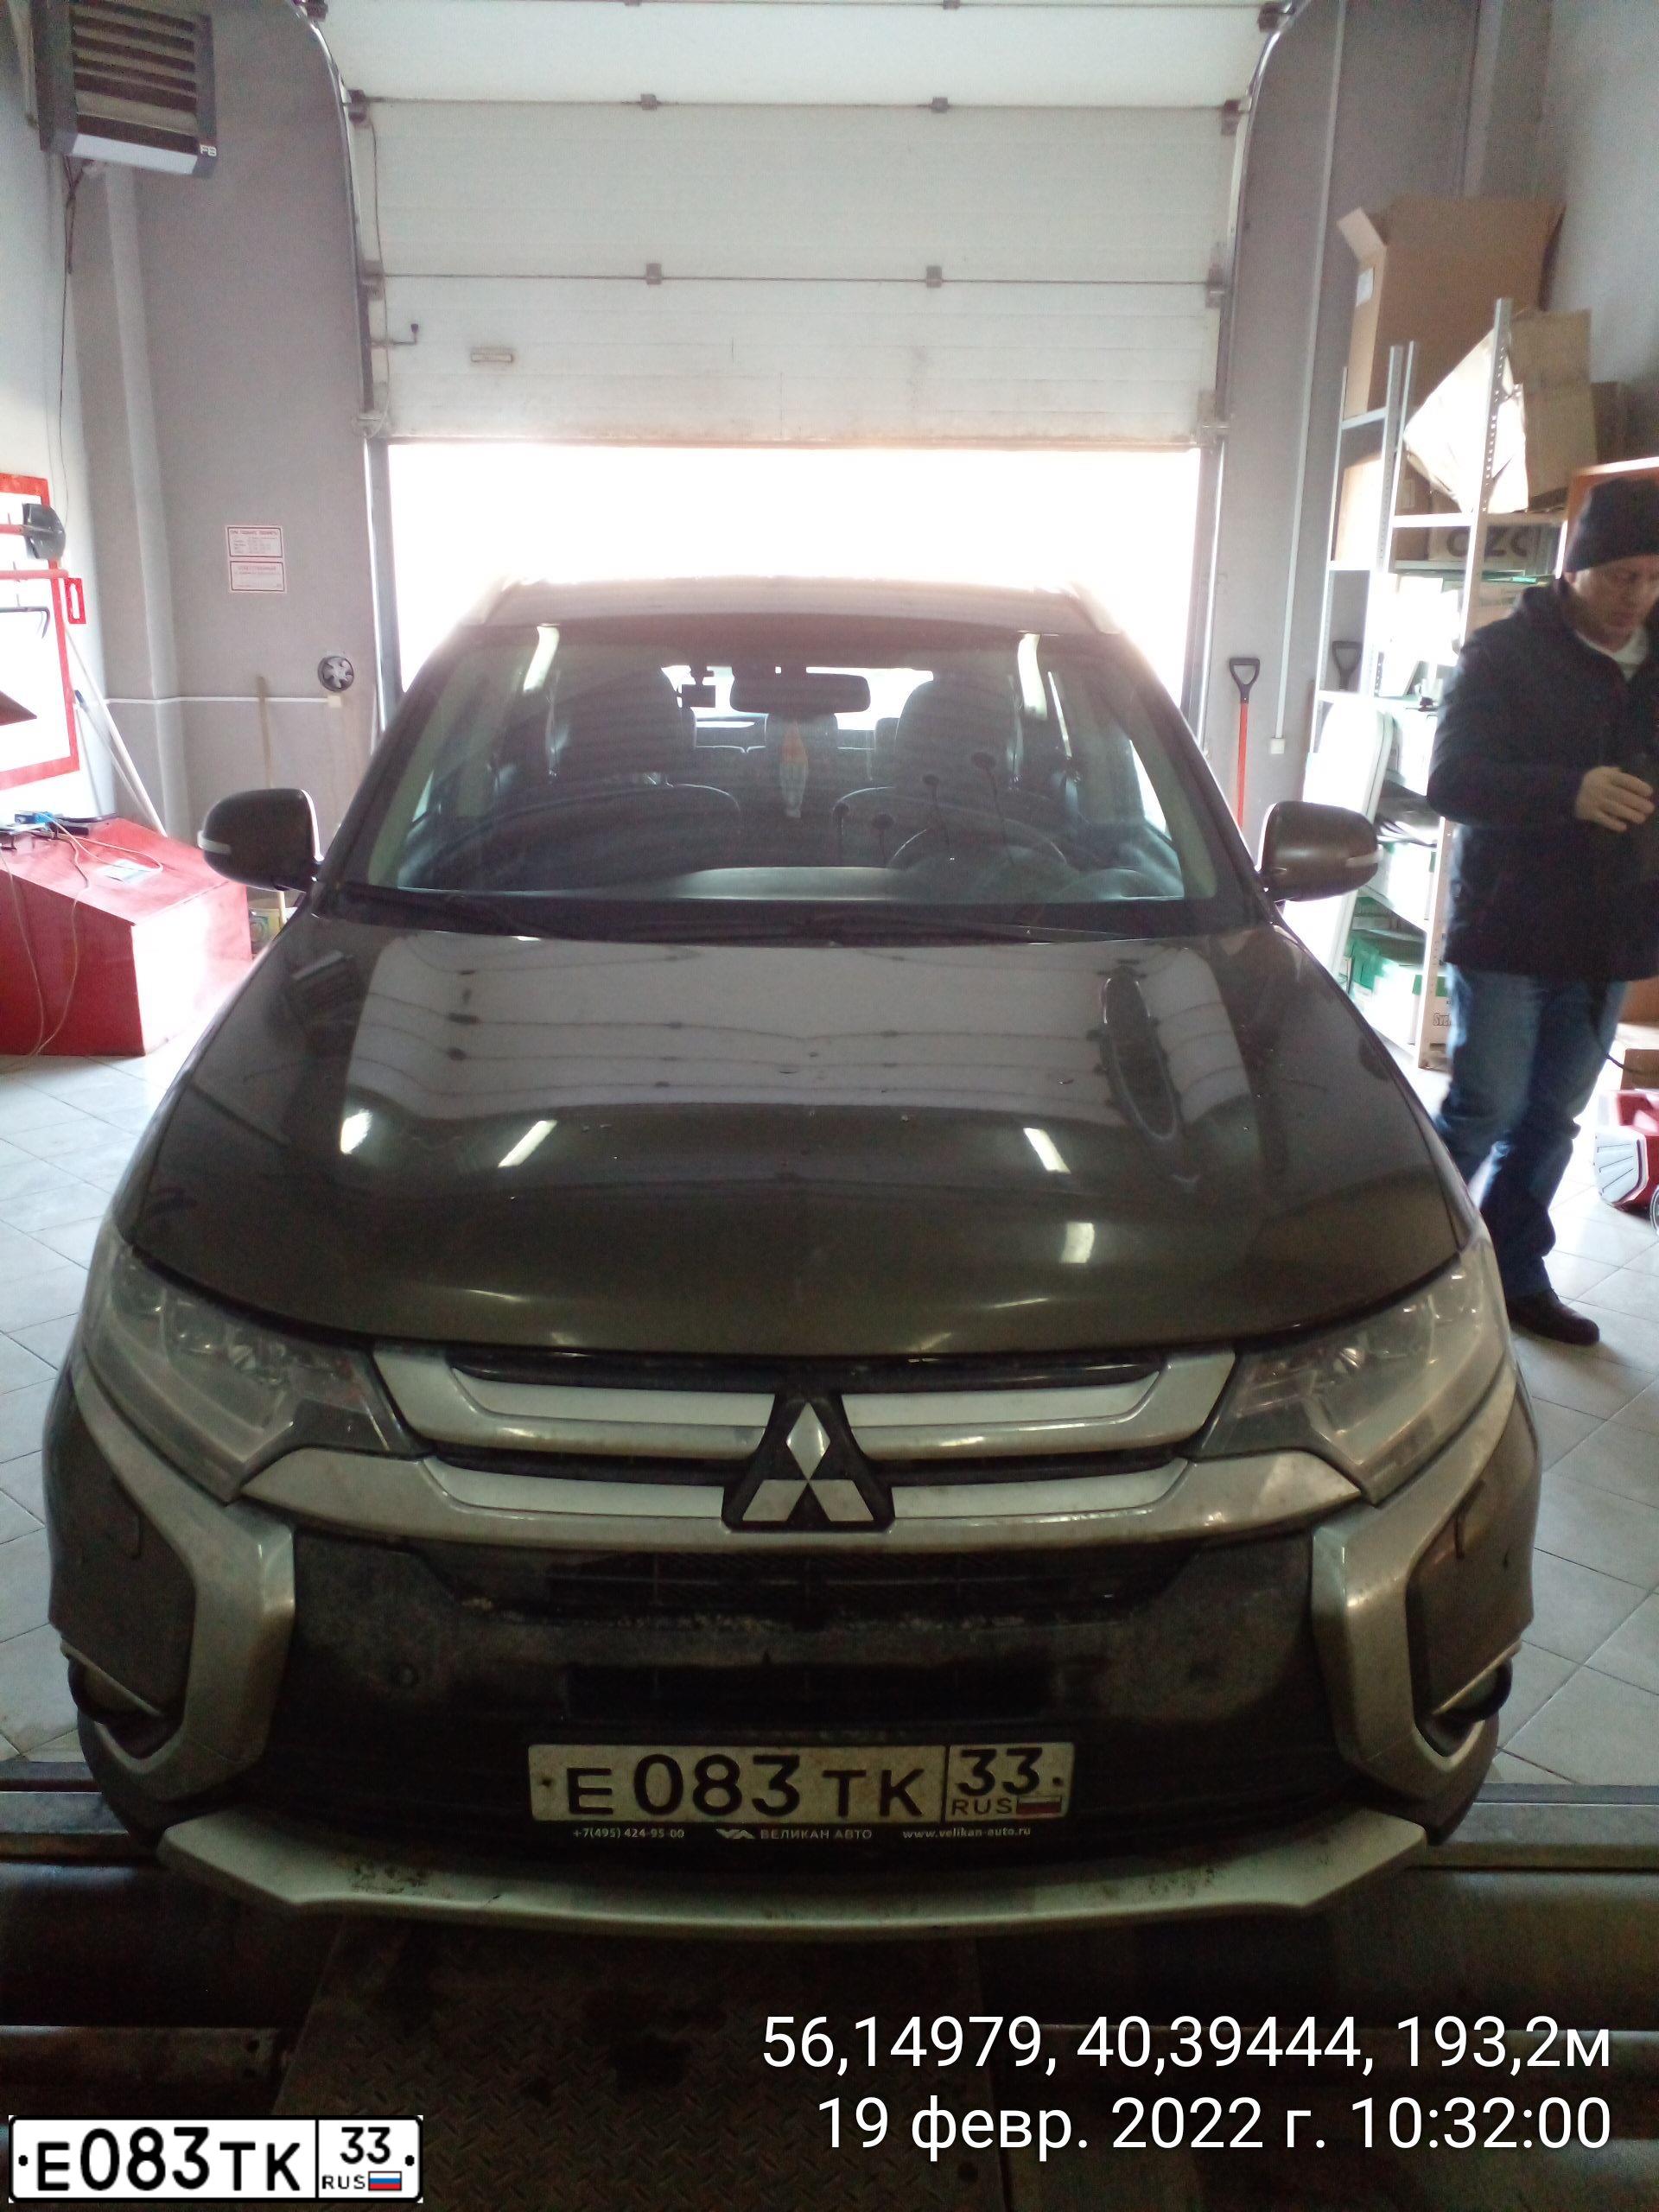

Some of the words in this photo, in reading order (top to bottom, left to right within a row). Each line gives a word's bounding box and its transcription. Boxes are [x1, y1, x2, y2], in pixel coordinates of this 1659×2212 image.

[957, 1749, 1044, 1797] 33
[951, 1797, 1013, 1816] RUS
[760, 1828, 830, 1840] ВЕЛИКАН
[835, 1828, 873, 1840] АВТО
[902, 1827, 1031, 1839] www.velikan-auto.ru
